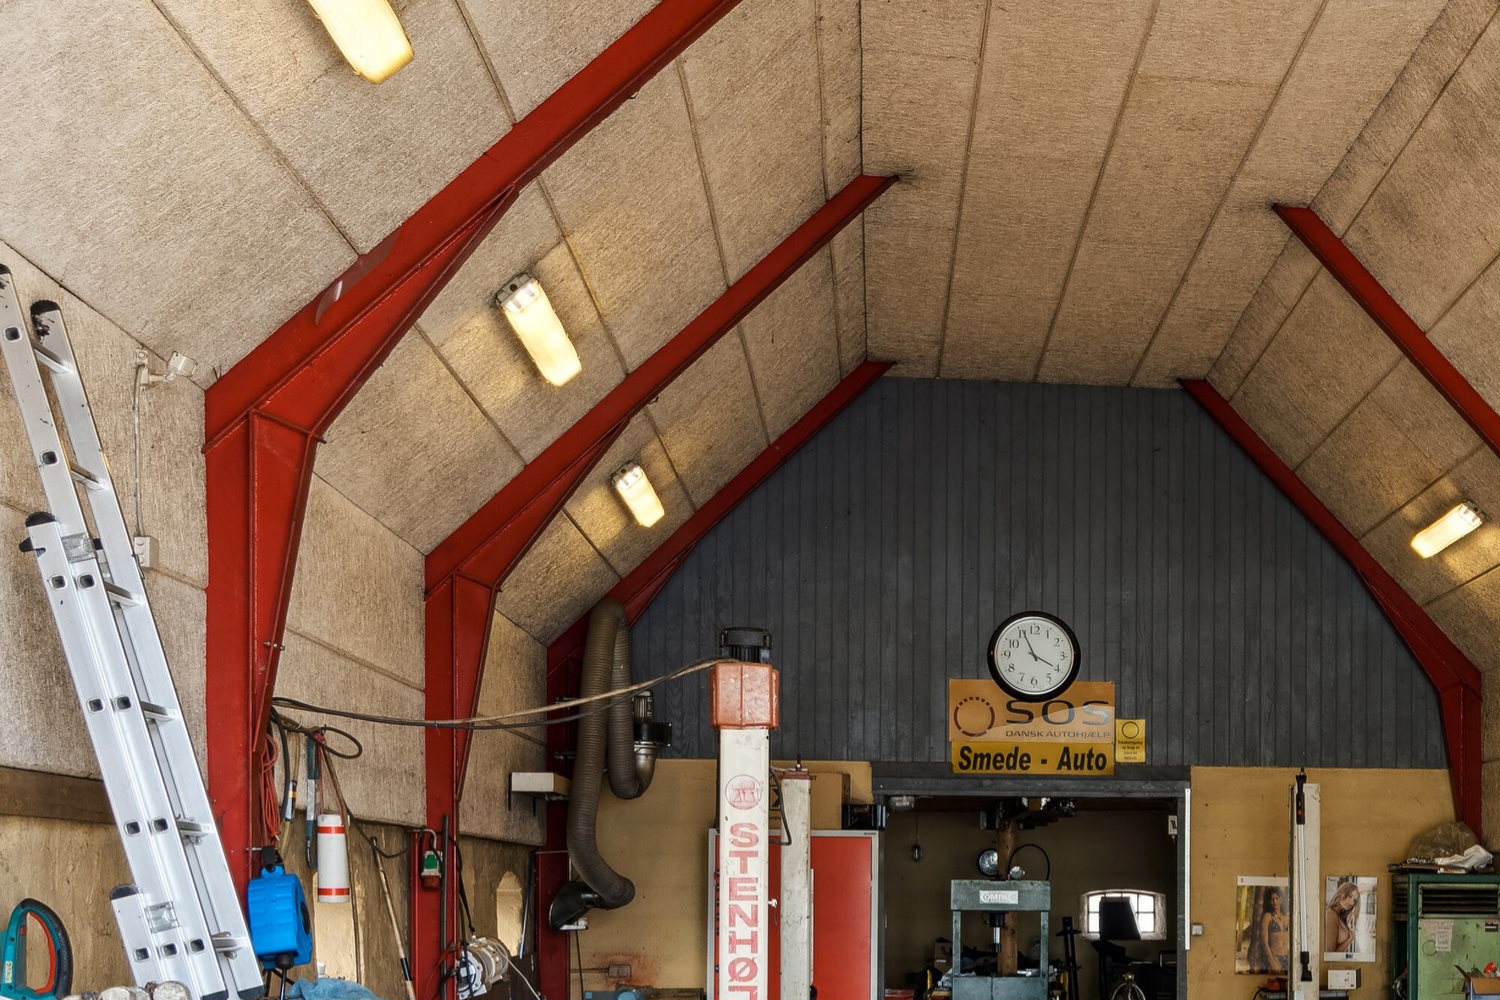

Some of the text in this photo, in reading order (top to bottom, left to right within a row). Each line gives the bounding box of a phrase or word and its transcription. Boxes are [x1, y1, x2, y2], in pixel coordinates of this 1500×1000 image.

[1029, 625, 1041, 635] 12
[1046, 629, 1050, 639] 1
[1009, 639, 1020, 649] 10
[1054, 638, 1060, 647] 2
[1003, 650, 1011, 660] 9
[1060, 651, 1066, 661] 3
[1008, 663, 1015, 673] 8
[1054, 664, 1060, 673] 4
[1019, 672, 1026, 682] 7
[1030, 676, 1038, 686] 6
[1046, 673, 1052, 682] 5
[1006, 699, 1110, 726] SOS
[1045, 731, 1111, 739] AUTOHJÆLP
[958, 746, 1032, 771] Smede
[1057, 747, 1107, 771] Auto
